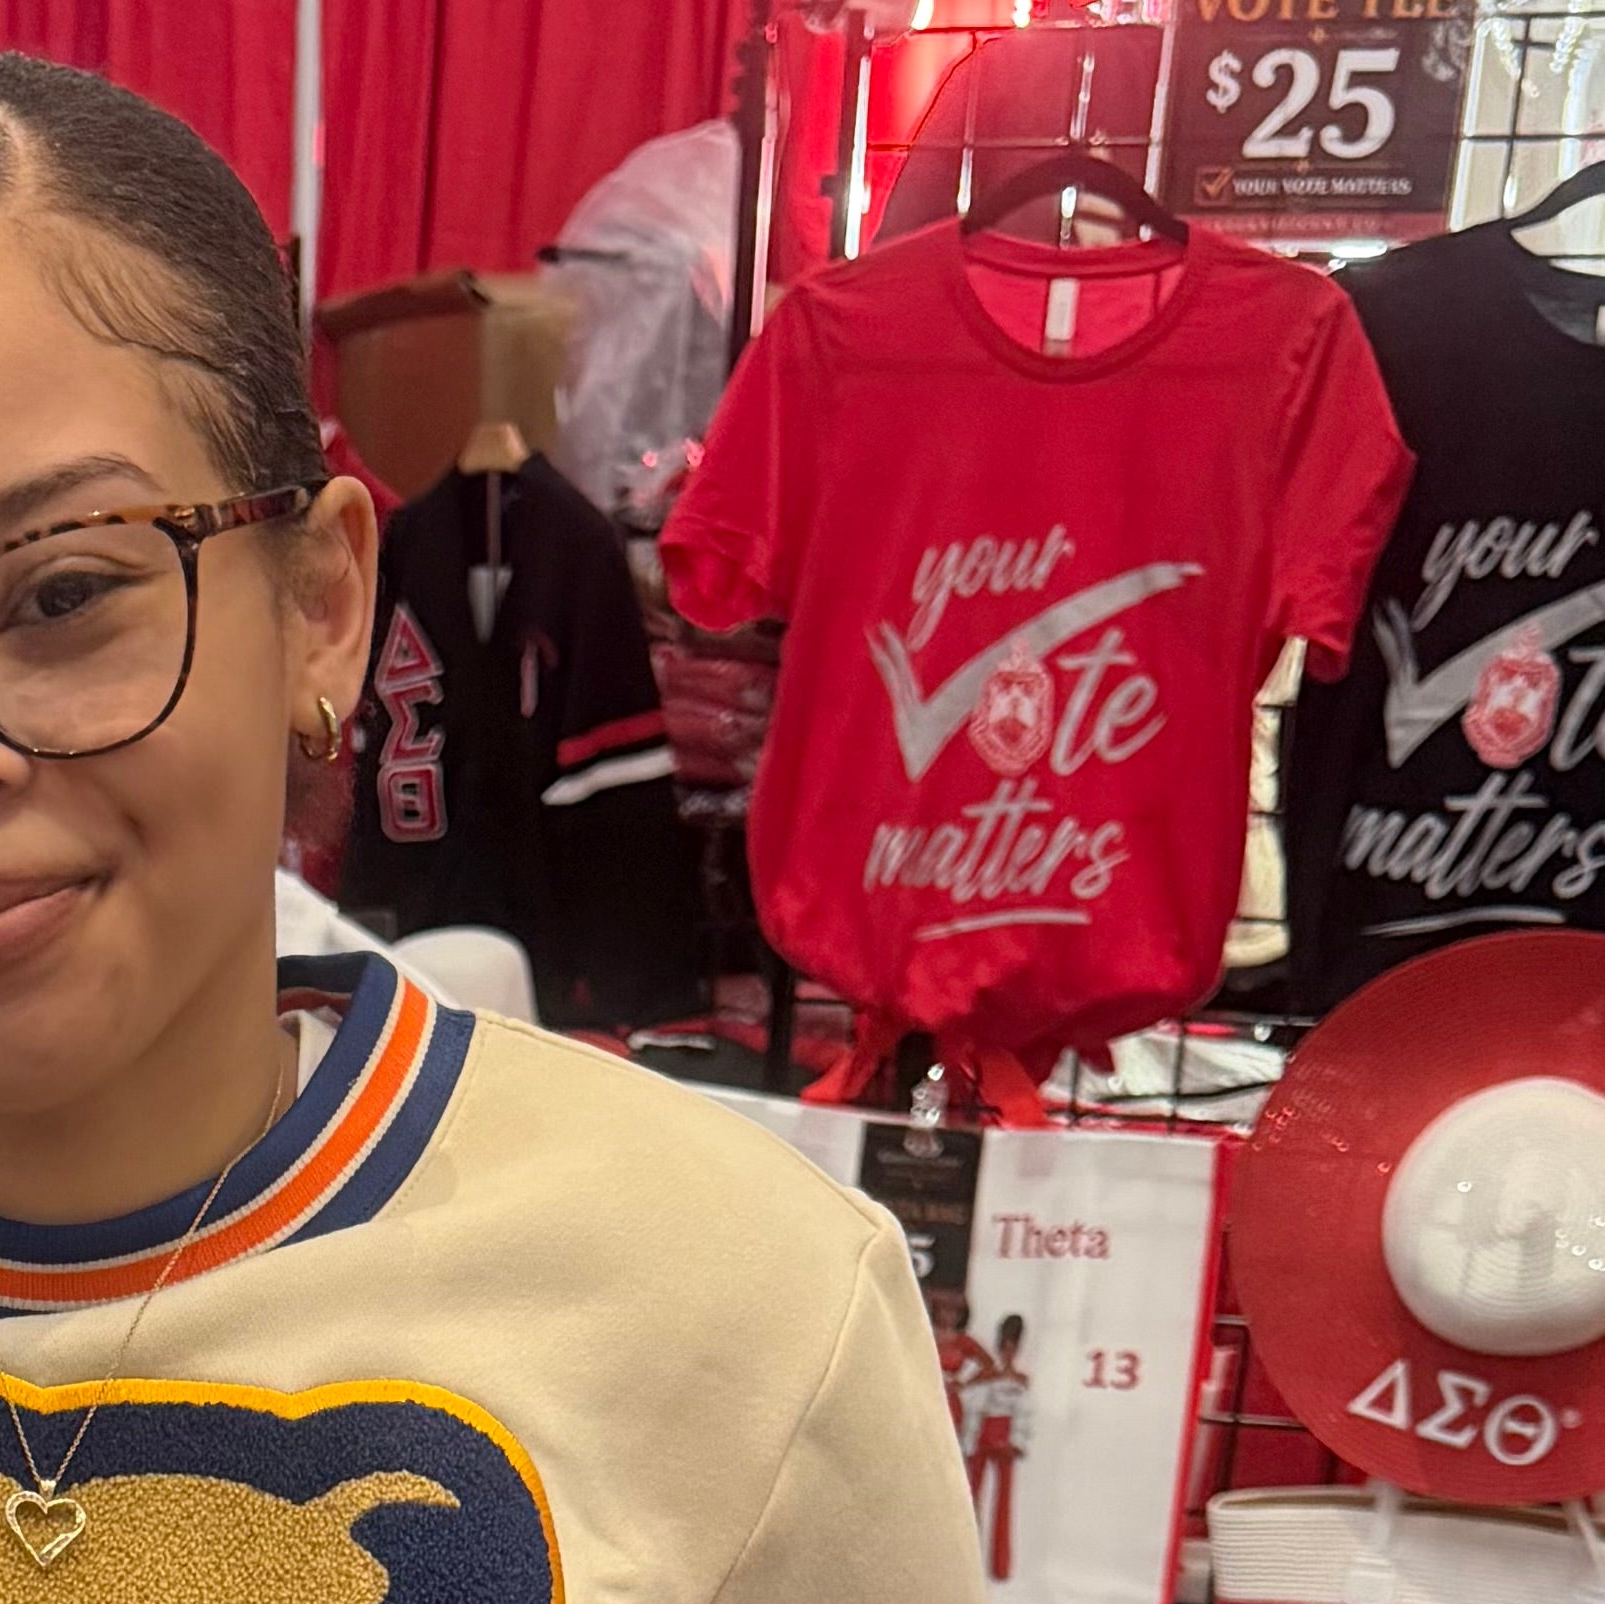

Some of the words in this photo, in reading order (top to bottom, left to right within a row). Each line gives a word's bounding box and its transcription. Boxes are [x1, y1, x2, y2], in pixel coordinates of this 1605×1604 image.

[1205, 47, 1401, 160] $25
[907, 523, 1077, 654] your
[1410, 510, 1601, 633] your
[862, 776, 1132, 902] matters
[992, 1213, 1110, 1260] Theta
[1081, 1350, 1141, 1390] 13
